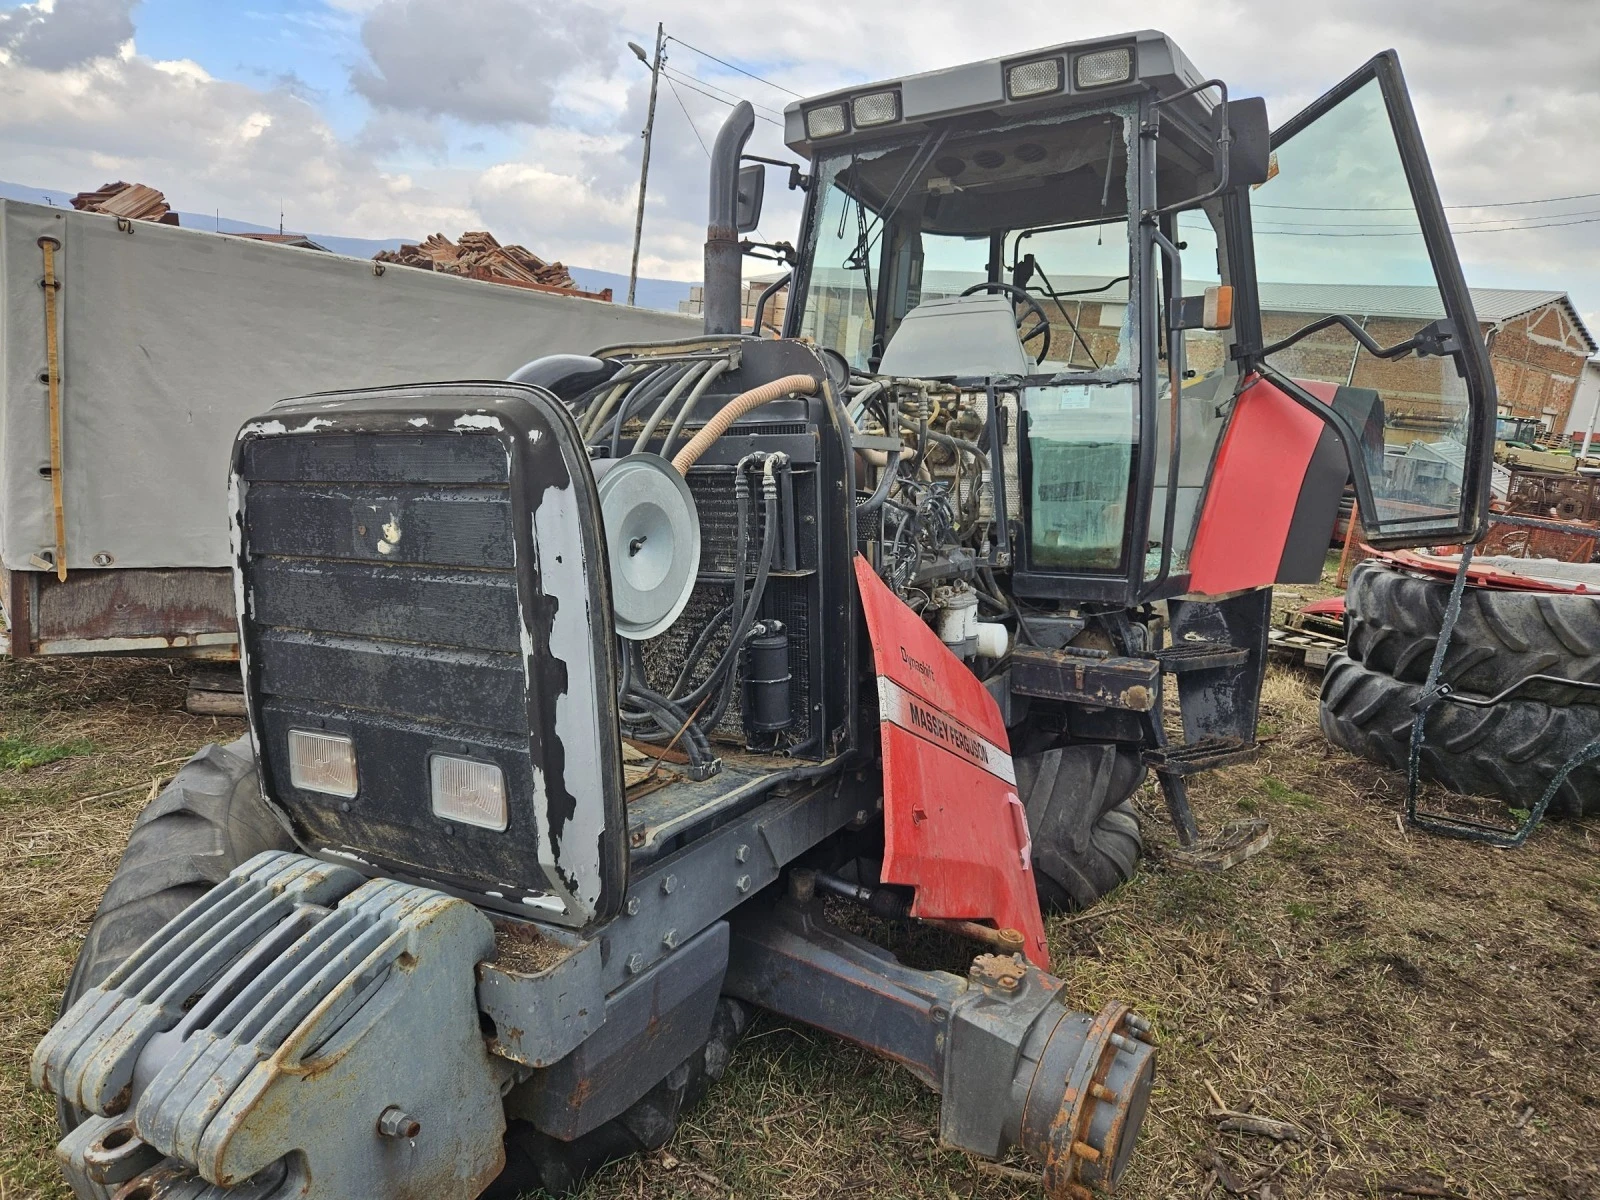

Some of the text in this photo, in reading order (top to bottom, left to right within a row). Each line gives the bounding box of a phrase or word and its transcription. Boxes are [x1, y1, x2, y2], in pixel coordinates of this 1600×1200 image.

[900, 646, 935, 682] Dynashift
[909, 702, 989, 764] MASSEY FERGUSON
